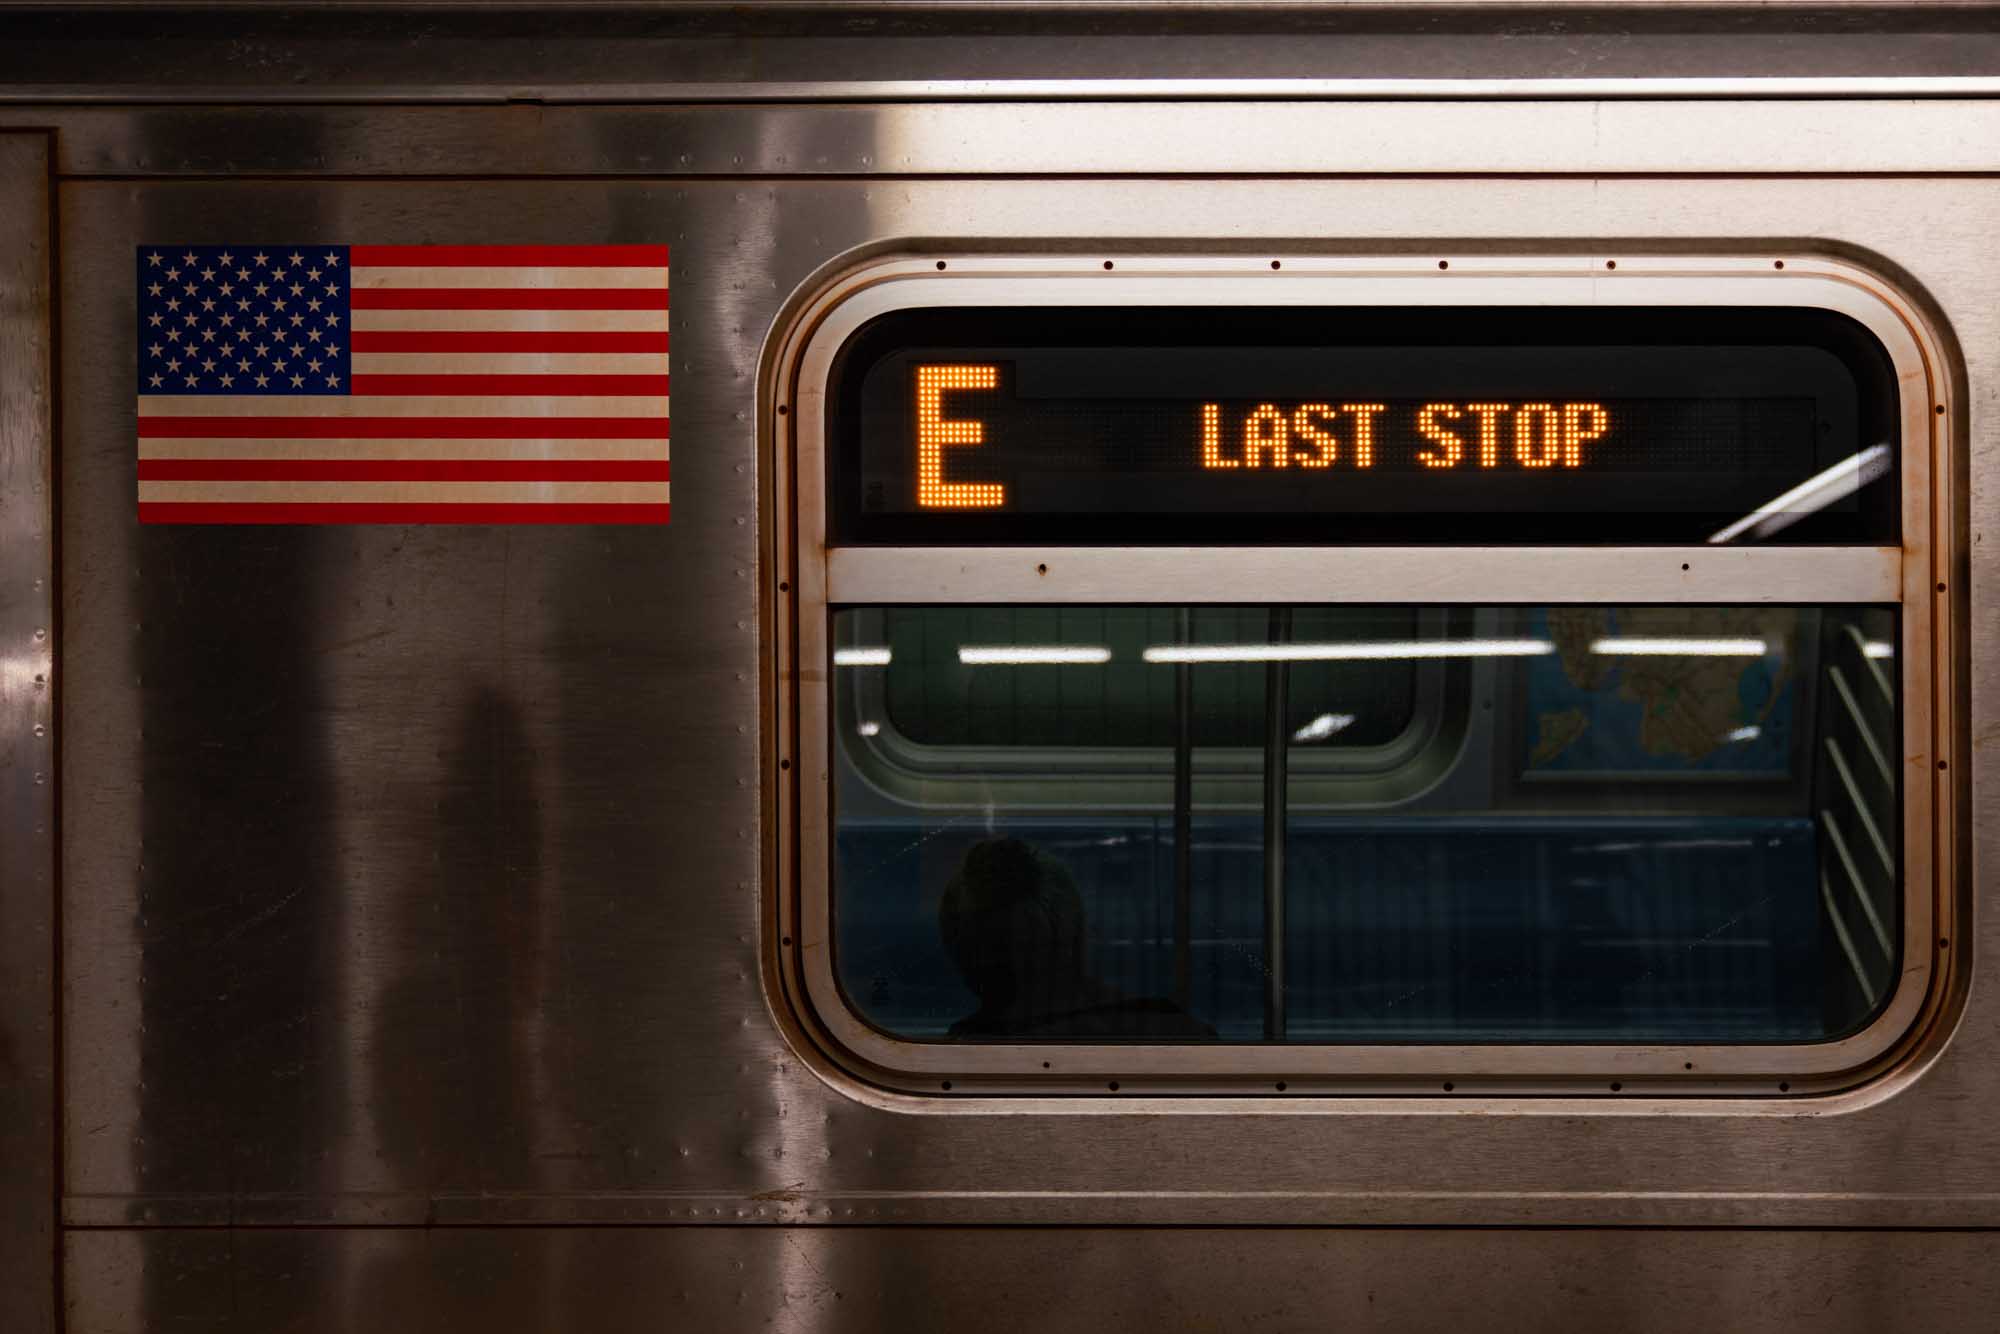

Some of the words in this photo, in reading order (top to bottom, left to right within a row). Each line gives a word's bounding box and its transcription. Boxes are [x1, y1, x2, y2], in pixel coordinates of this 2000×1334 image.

[917, 365, 1006, 509] E
[1201, 402, 1387, 470] LAST
[1416, 402, 1608, 470] STOP
